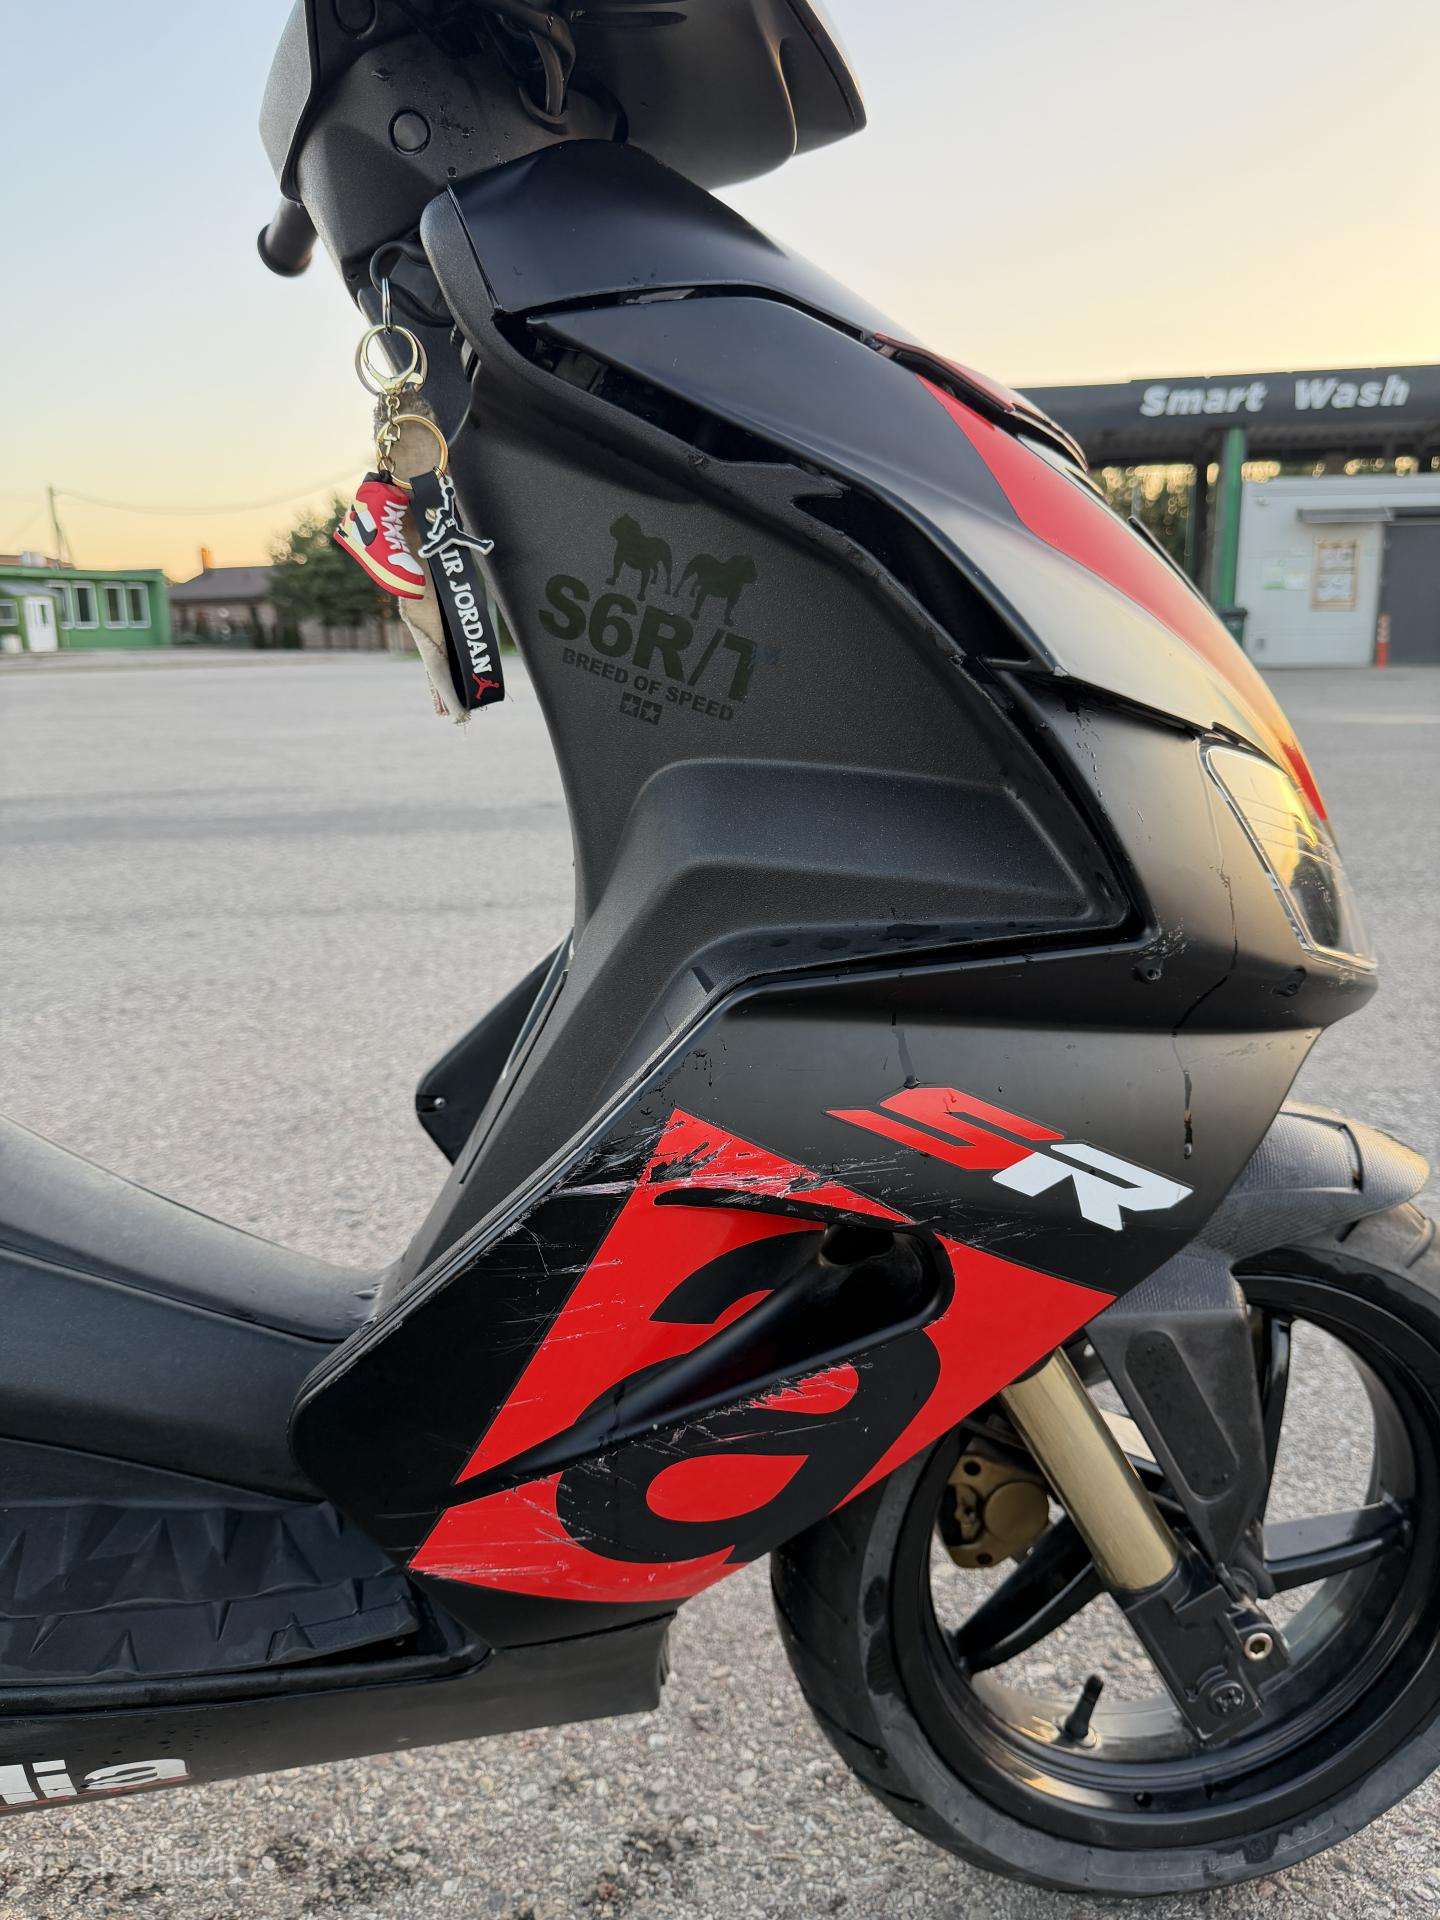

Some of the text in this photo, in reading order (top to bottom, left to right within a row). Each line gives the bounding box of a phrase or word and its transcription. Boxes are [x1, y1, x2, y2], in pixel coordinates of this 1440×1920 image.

[1140, 374, 1410, 417] Smart Wash
[450, 581, 493, 674] JORDAN
[561, 647, 734, 721] BREED OF SPEED
